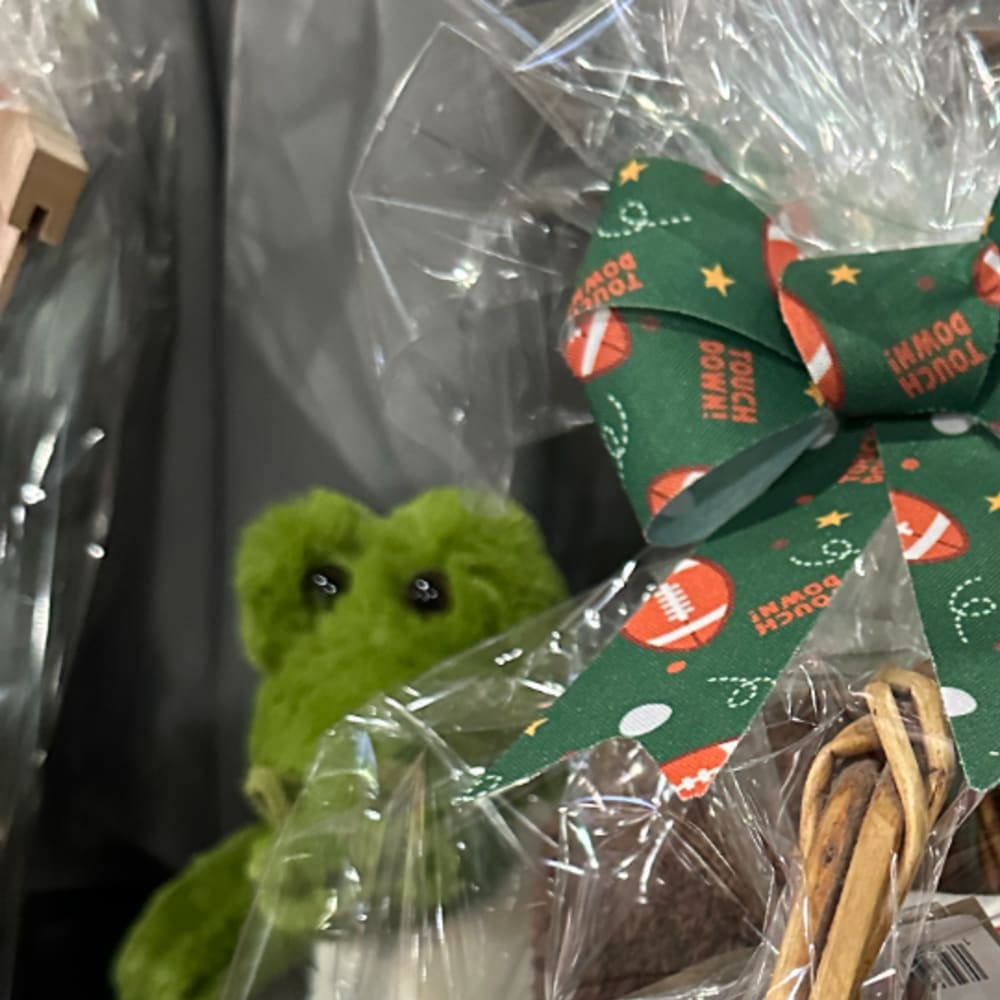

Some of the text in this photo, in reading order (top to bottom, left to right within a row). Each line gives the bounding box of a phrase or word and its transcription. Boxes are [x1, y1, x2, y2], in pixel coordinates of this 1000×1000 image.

[883, 310, 972, 375] DOWN!
[900, 340, 987, 399] TOUCH
[699, 338, 729, 420] DOWN!
[728, 348, 758, 424] TOUCH
[748, 573, 843, 624] DOWN!
